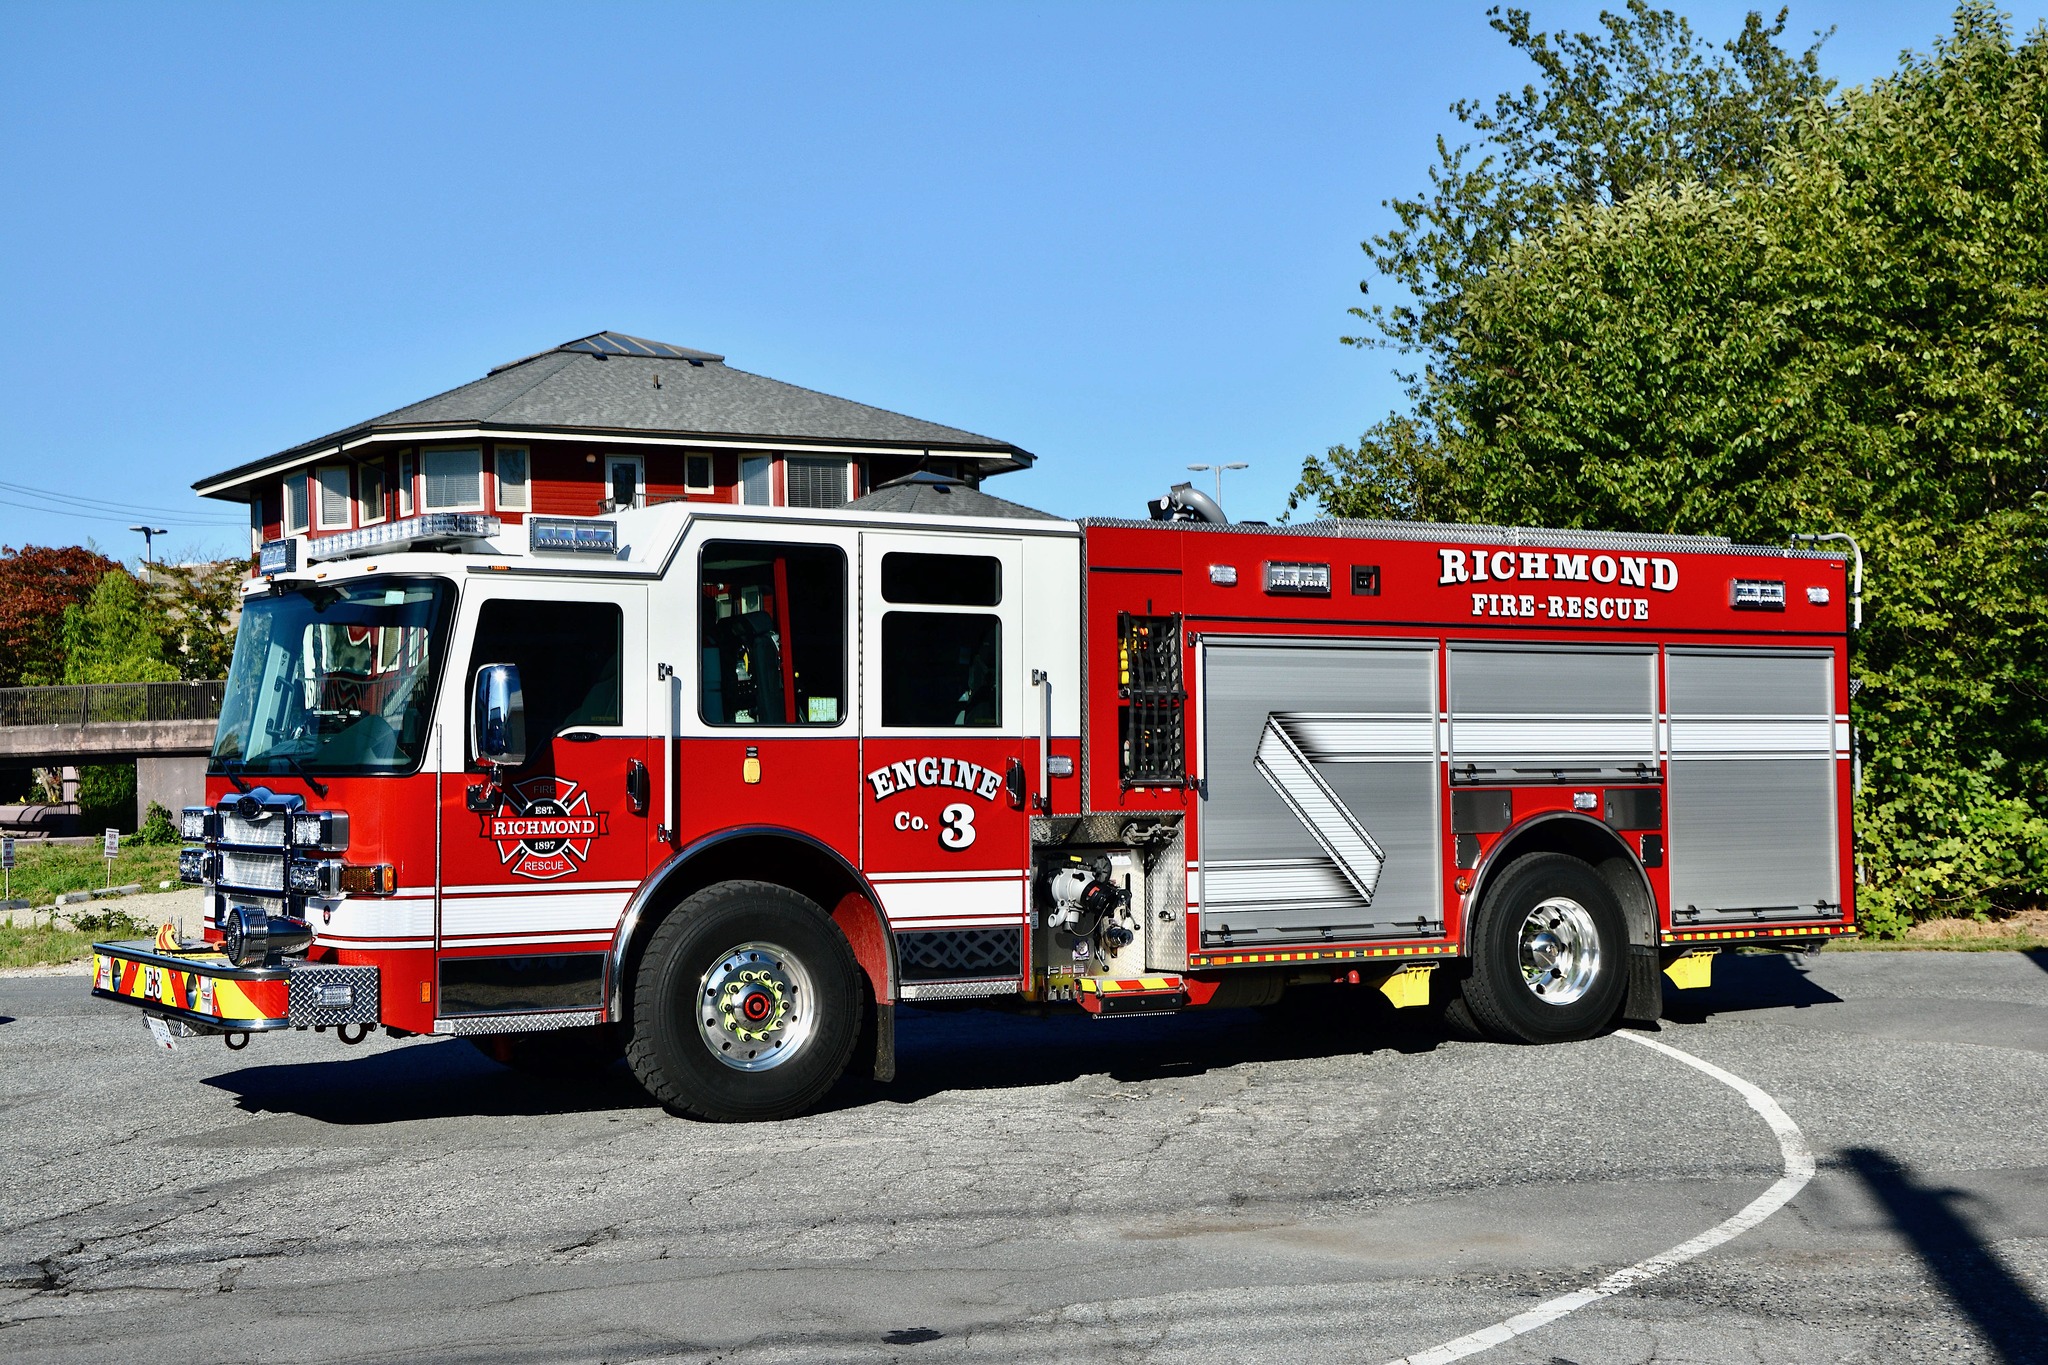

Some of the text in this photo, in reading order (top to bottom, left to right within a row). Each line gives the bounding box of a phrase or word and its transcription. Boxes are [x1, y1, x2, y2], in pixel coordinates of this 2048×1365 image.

[1438, 549, 1679, 592] RICHMOND
[1471, 593, 1649, 620] FIRE-RESCUE
[533, 785, 556, 794] FIRE
[867, 756, 1003, 801] ENGINE
[534, 806, 556, 815] EST.
[493, 819, 596, 836] RICHMOND
[894, 803, 976, 849] Co. 3
[534, 841, 556, 851] 1897
[524, 861, 564, 871] RESCUE
[145, 966, 162, 1000] E3
